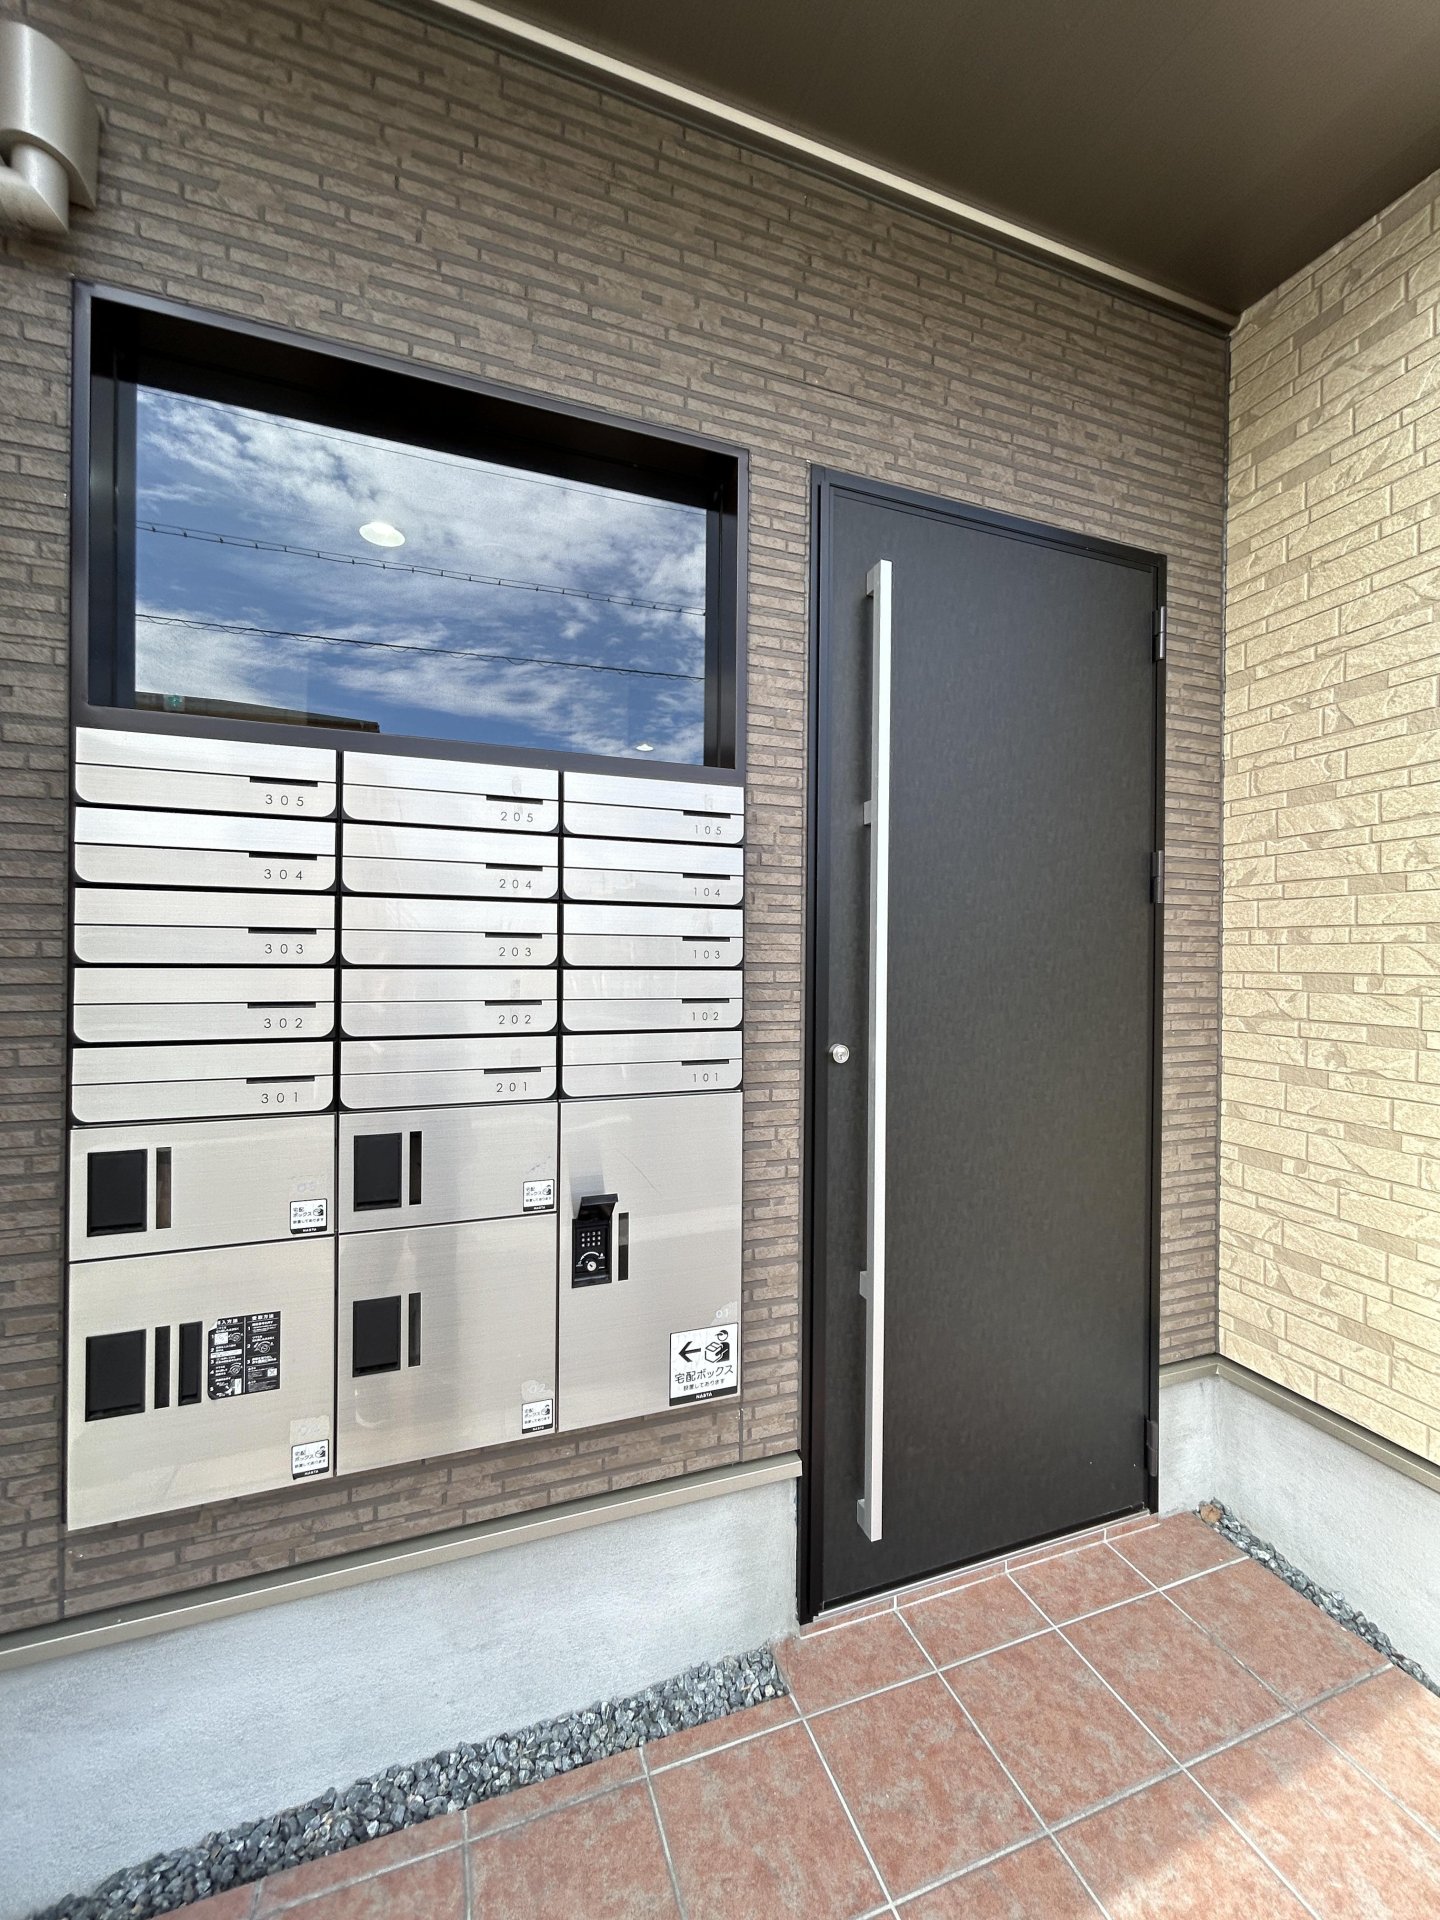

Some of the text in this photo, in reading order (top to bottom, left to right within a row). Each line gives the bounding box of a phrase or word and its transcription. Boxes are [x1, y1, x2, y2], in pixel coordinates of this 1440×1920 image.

[265, 794, 304, 807] 305
[500, 811, 534, 823] 205
[695, 824, 722, 836] 105
[264, 868, 304, 881] 304
[499, 878, 532, 890] 204
[694, 887, 721, 897] 104
[264, 943, 304, 955] 303
[498, 946, 532, 957] 203
[693, 950, 721, 960] 103
[498, 1014, 532, 1025] 202
[692, 1011, 719, 1021] 102
[263, 1017, 303, 1029] 302
[693, 1072, 718, 1083] 101
[496, 1082, 527, 1093] 201
[261, 1091, 298, 1104] 301
[674, 1365, 734, 1385] 宅配ボックス
[683, 1378, 725, 1391] 設置してあります
[695, 1391, 713, 1400] NASTA
